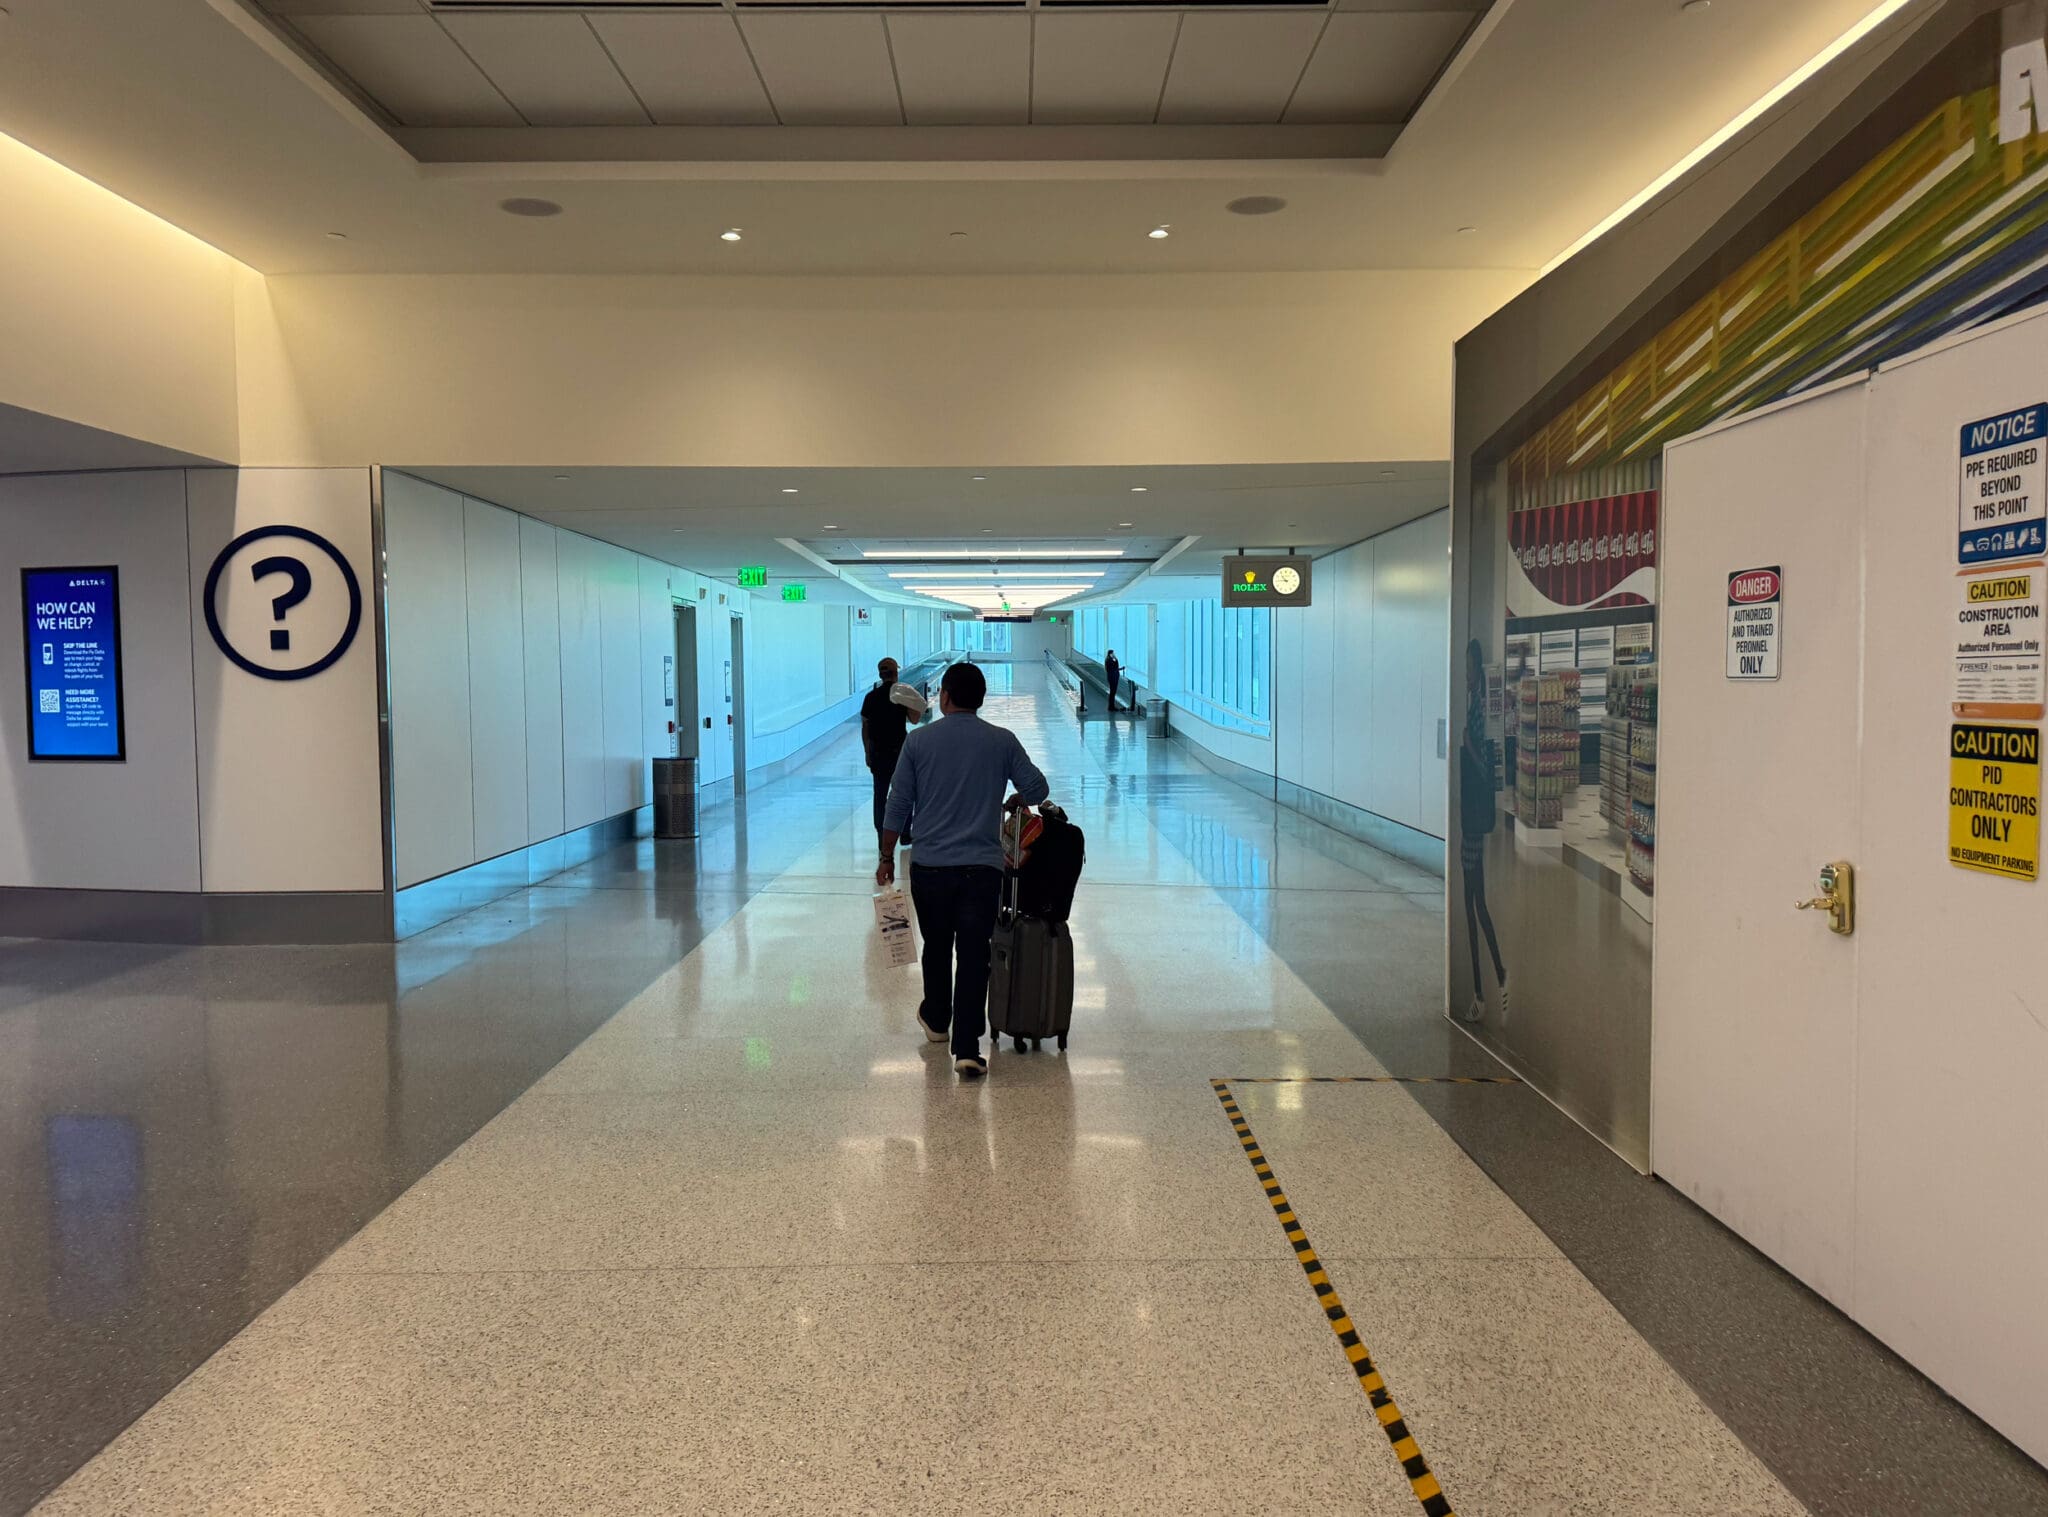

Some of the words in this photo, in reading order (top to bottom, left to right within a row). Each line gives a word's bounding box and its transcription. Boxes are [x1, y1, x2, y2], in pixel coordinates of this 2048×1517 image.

[1971, 410, 2037, 449] NOTICE
[1966, 460, 1985, 479] PPE
[1987, 447, 2038, 474] REQUIRED
[1980, 475, 2021, 497] BEYOND
[1973, 502, 1995, 521] THIS
[1998, 496, 2029, 517] POINT
[741, 567, 766, 585] EXIT
[783, 584, 806, 600] EXIT
[1233, 583, 1267, 592] ROLEX
[1735, 576, 1772, 598] DANGER
[1970, 579, 2027, 600] CAUTION
[36, 602, 67, 615] HOW
[70, 601, 96, 614] CAN
[1733, 607, 1773, 622] AUTHORIZED
[1959, 605, 2039, 623] CONSTRUCTION
[36, 617, 56, 630] WE
[59, 616, 94, 630] HELP?
[1732, 625, 1745, 638] AND
[1746, 623, 1774, 637] TRAINED
[1983, 623, 2011, 637] AREA
[1958, 642, 1990, 653] Authorized
[1991, 641, 2023, 651] Personnel
[2024, 640, 2039, 652] Only
[1740, 656, 1764, 674] ONLY
[1953, 730, 2036, 759] CAUTION
[1982, 765, 2002, 785] PID
[1950, 787, 2037, 817] CONTRACTORS
[1971, 814, 2012, 843] ONLY
[1951, 846, 1961, 859] NO
[1961, 849, 2000, 866] EQUIPMENT
[2002, 855, 2034, 872] PARKING
